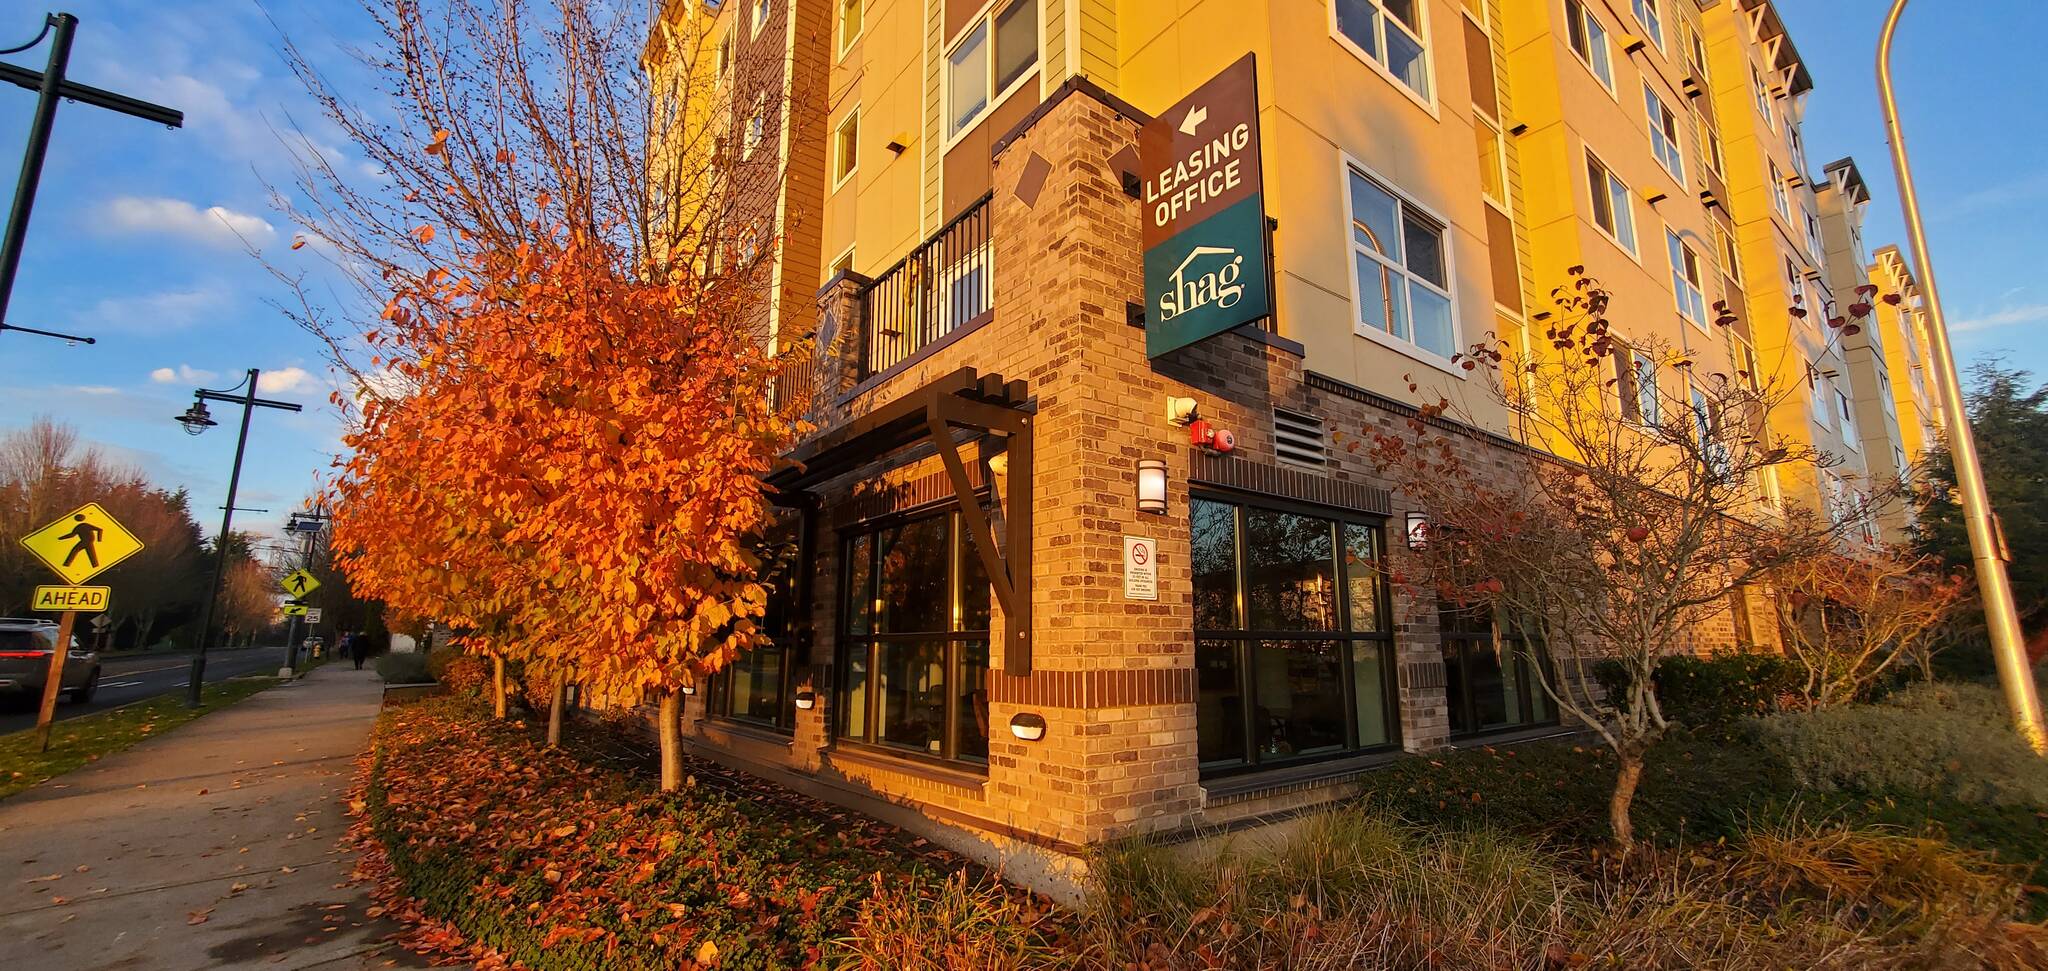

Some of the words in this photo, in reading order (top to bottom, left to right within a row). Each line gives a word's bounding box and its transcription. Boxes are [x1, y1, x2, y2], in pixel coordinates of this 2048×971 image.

[1146, 122, 1249, 204] LEASING
[1155, 158, 1241, 228] OFFICE
[1160, 255, 1243, 323] shag
[40, 591, 102, 605] AHEAD
